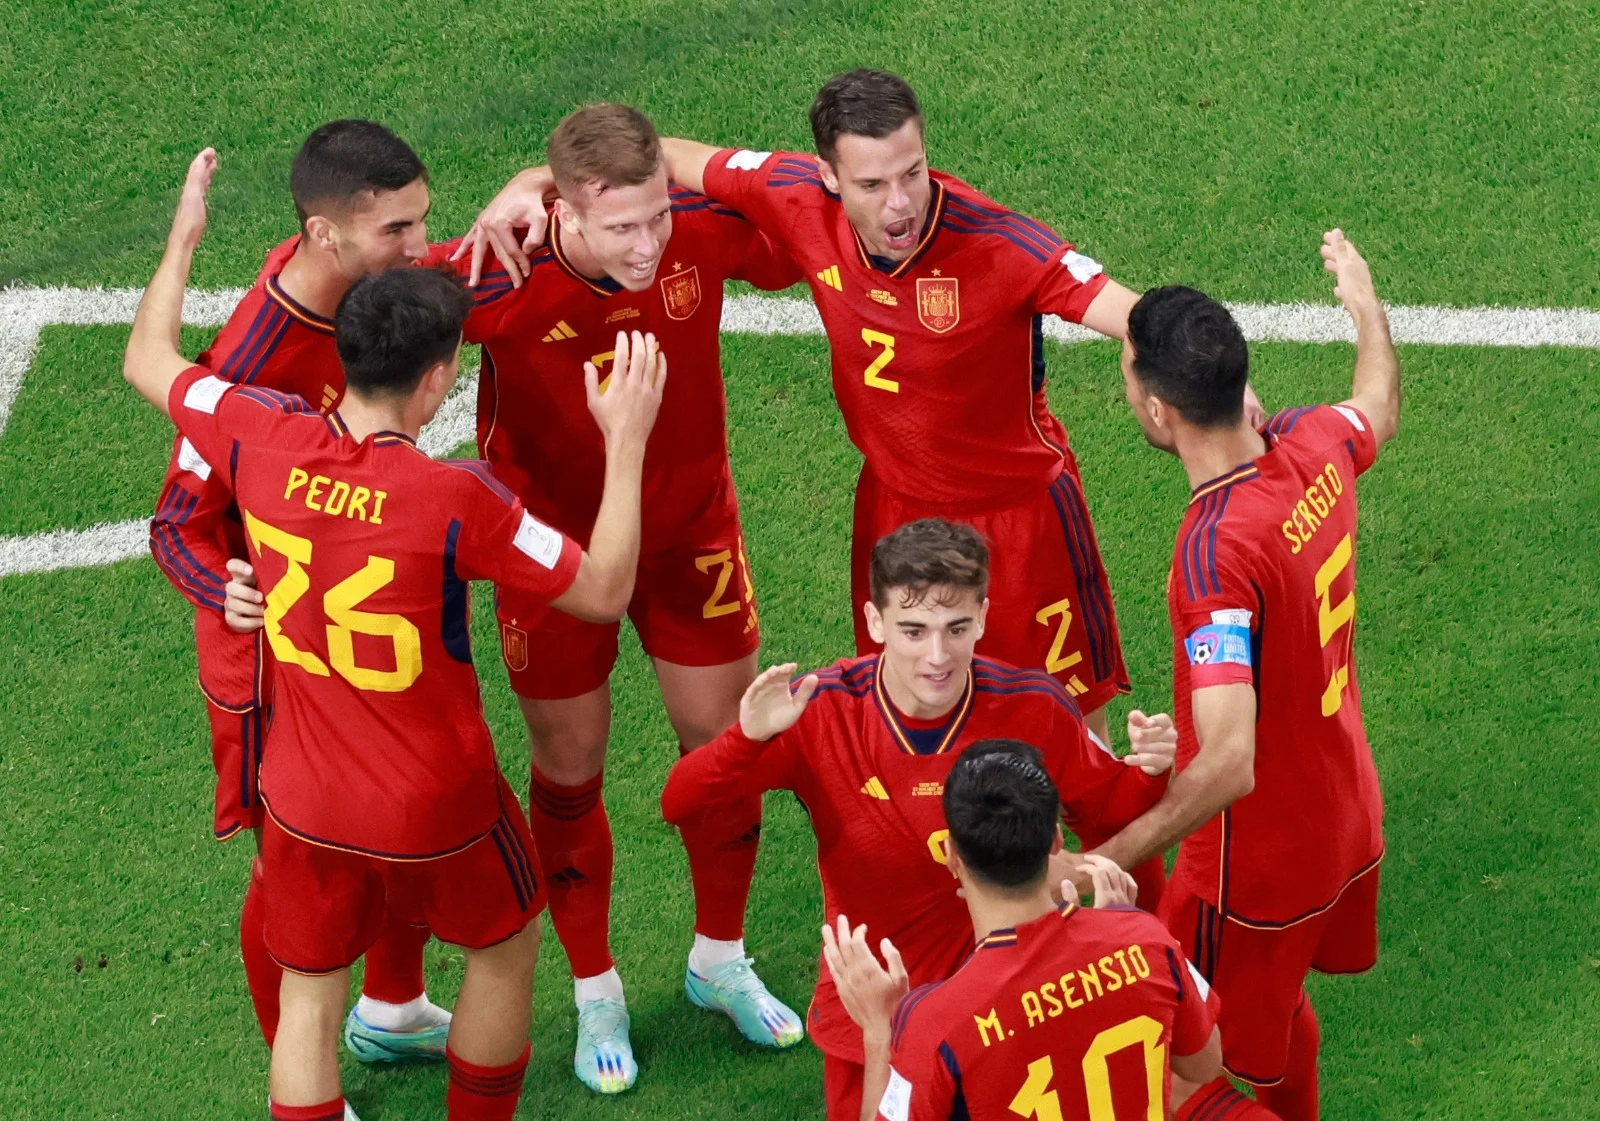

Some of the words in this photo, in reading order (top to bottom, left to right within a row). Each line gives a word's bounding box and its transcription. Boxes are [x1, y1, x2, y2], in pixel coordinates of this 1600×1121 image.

[861, 327, 899, 394] 2
[284, 467, 388, 525] PEDRI
[1282, 462, 1343, 554] SERGIO
[245, 509, 423, 692] 26
[1035, 598, 1083, 675] 2
[973, 1007, 1015, 1048] M.
[1021, 944, 1151, 1028] ASENSIO
[1008, 1014, 1165, 1121] 10
